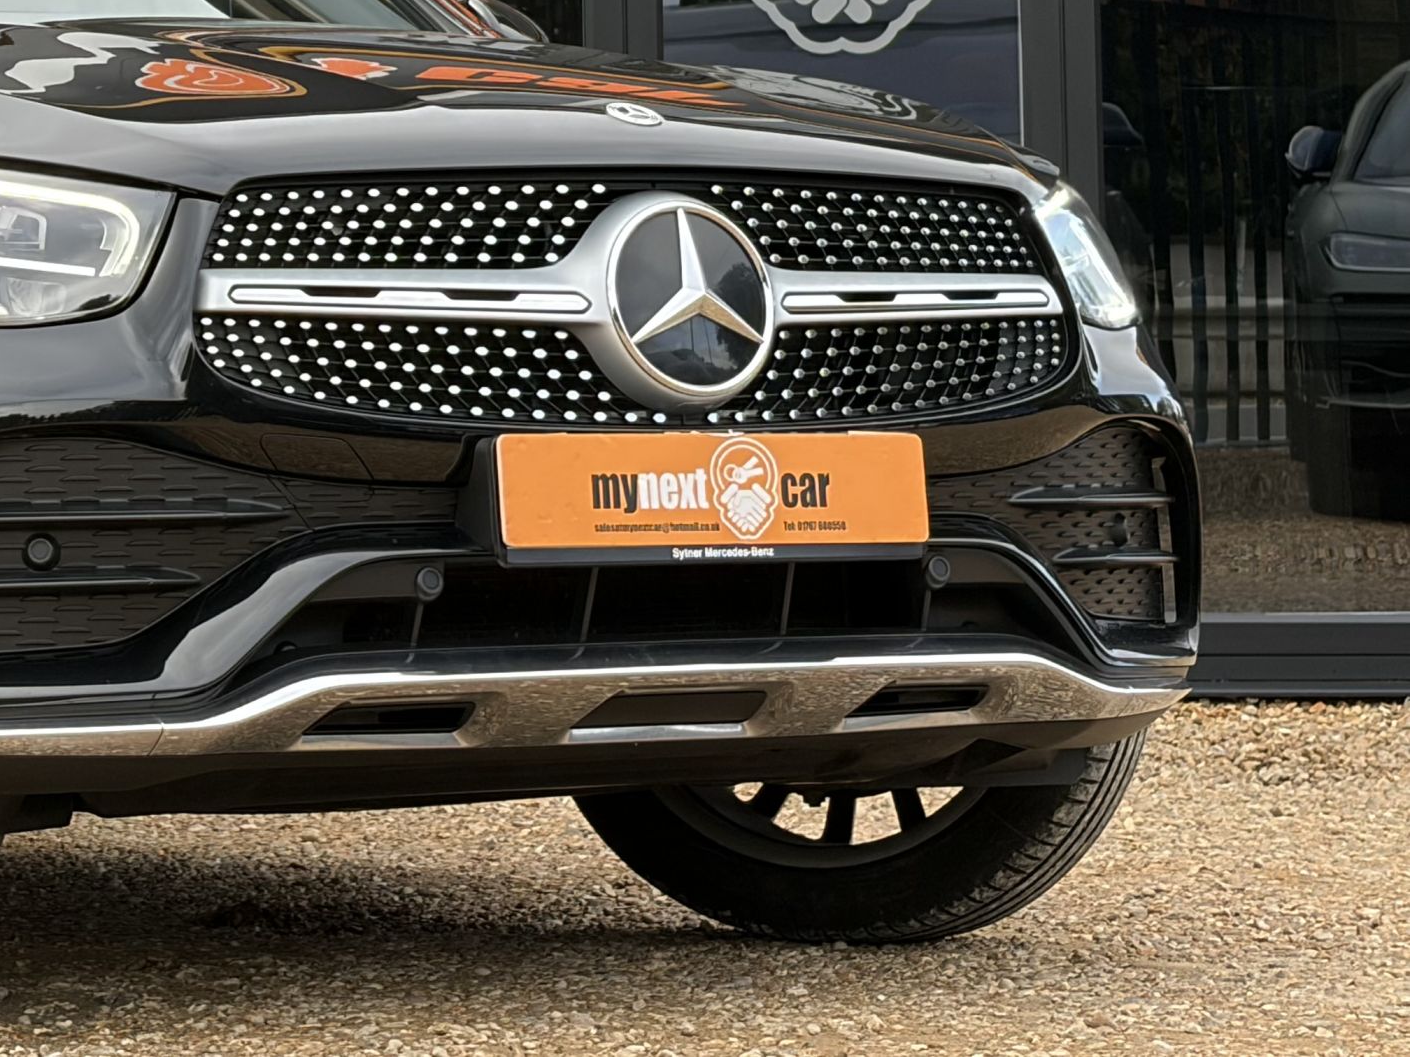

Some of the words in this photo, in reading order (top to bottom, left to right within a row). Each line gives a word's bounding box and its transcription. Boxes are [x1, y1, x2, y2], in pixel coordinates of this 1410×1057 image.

[781, 472, 829, 508] car
[672, 547, 702, 560] Sytner
[705, 546, 774, 558] Mercedes-Benz
